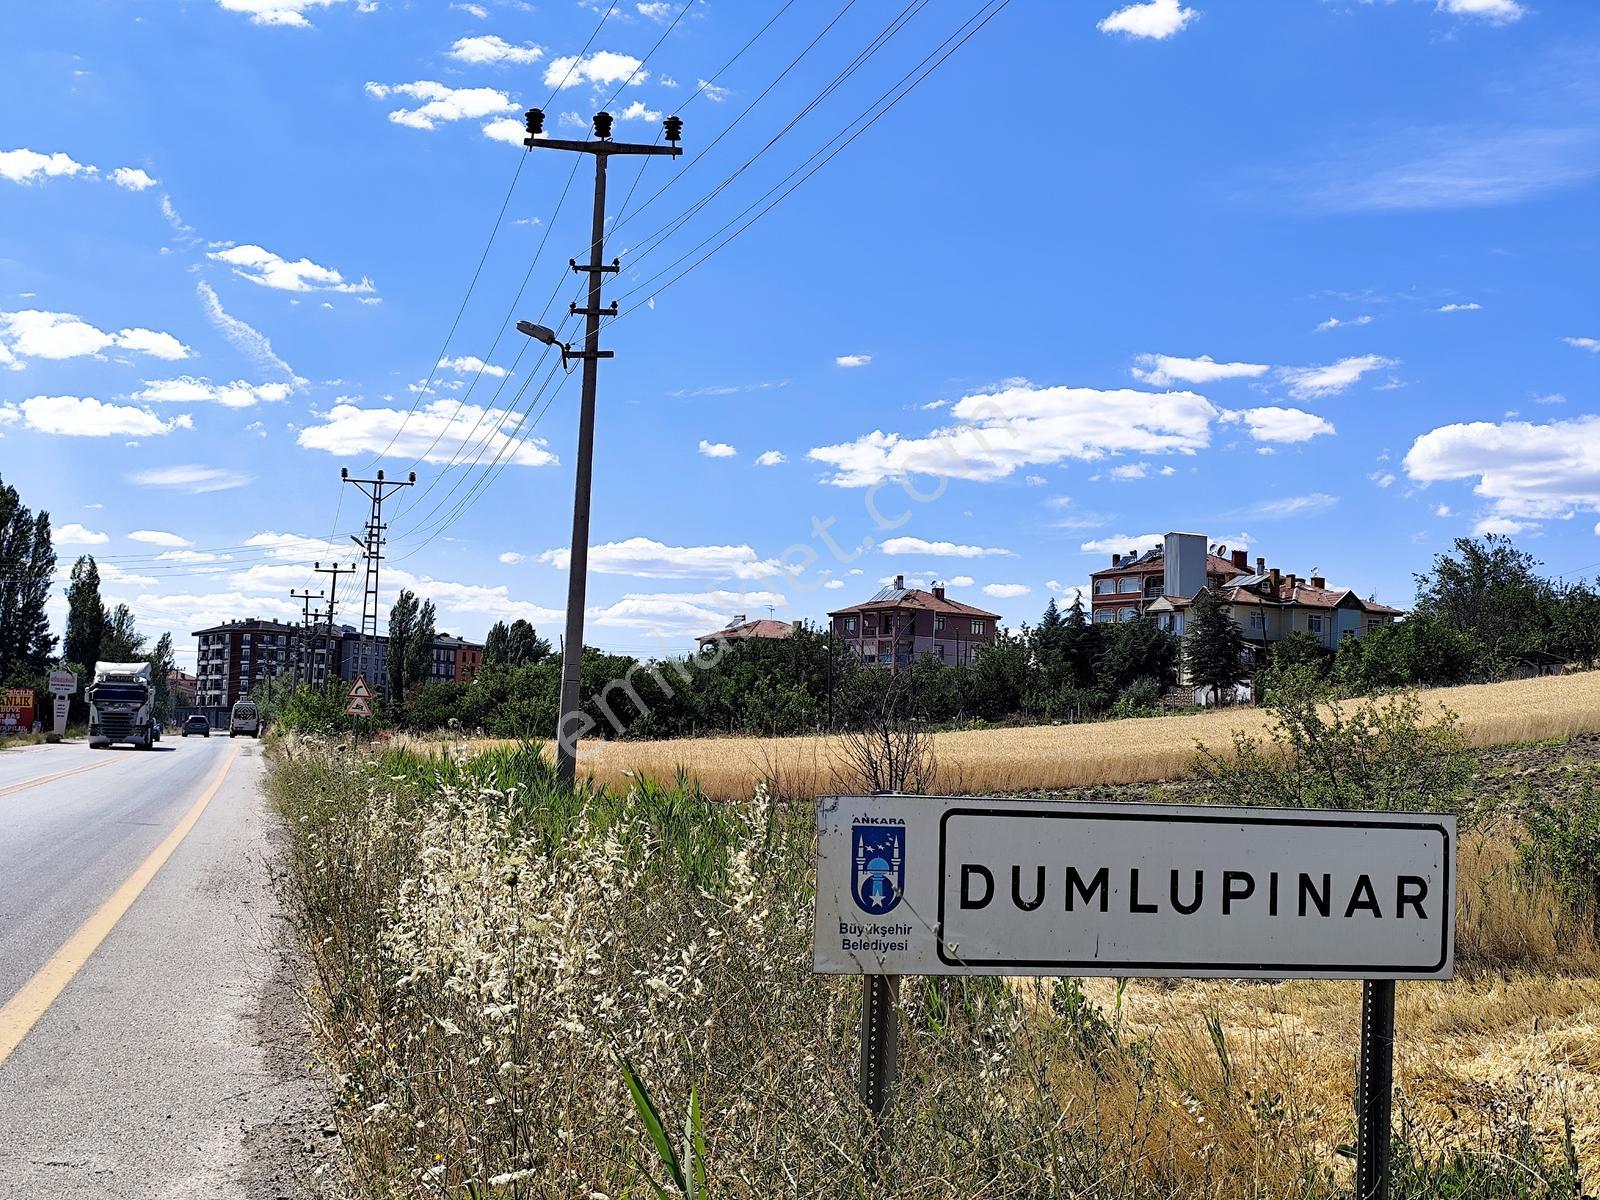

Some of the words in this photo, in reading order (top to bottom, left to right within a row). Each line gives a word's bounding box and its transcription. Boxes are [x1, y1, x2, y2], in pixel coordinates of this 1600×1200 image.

[852, 816, 906, 825] ANKARA
[960, 864, 1429, 919] DUMLUPINAR
[839, 922, 913, 937] Büyükşehir
[842, 938, 908, 953] Belediyesi
